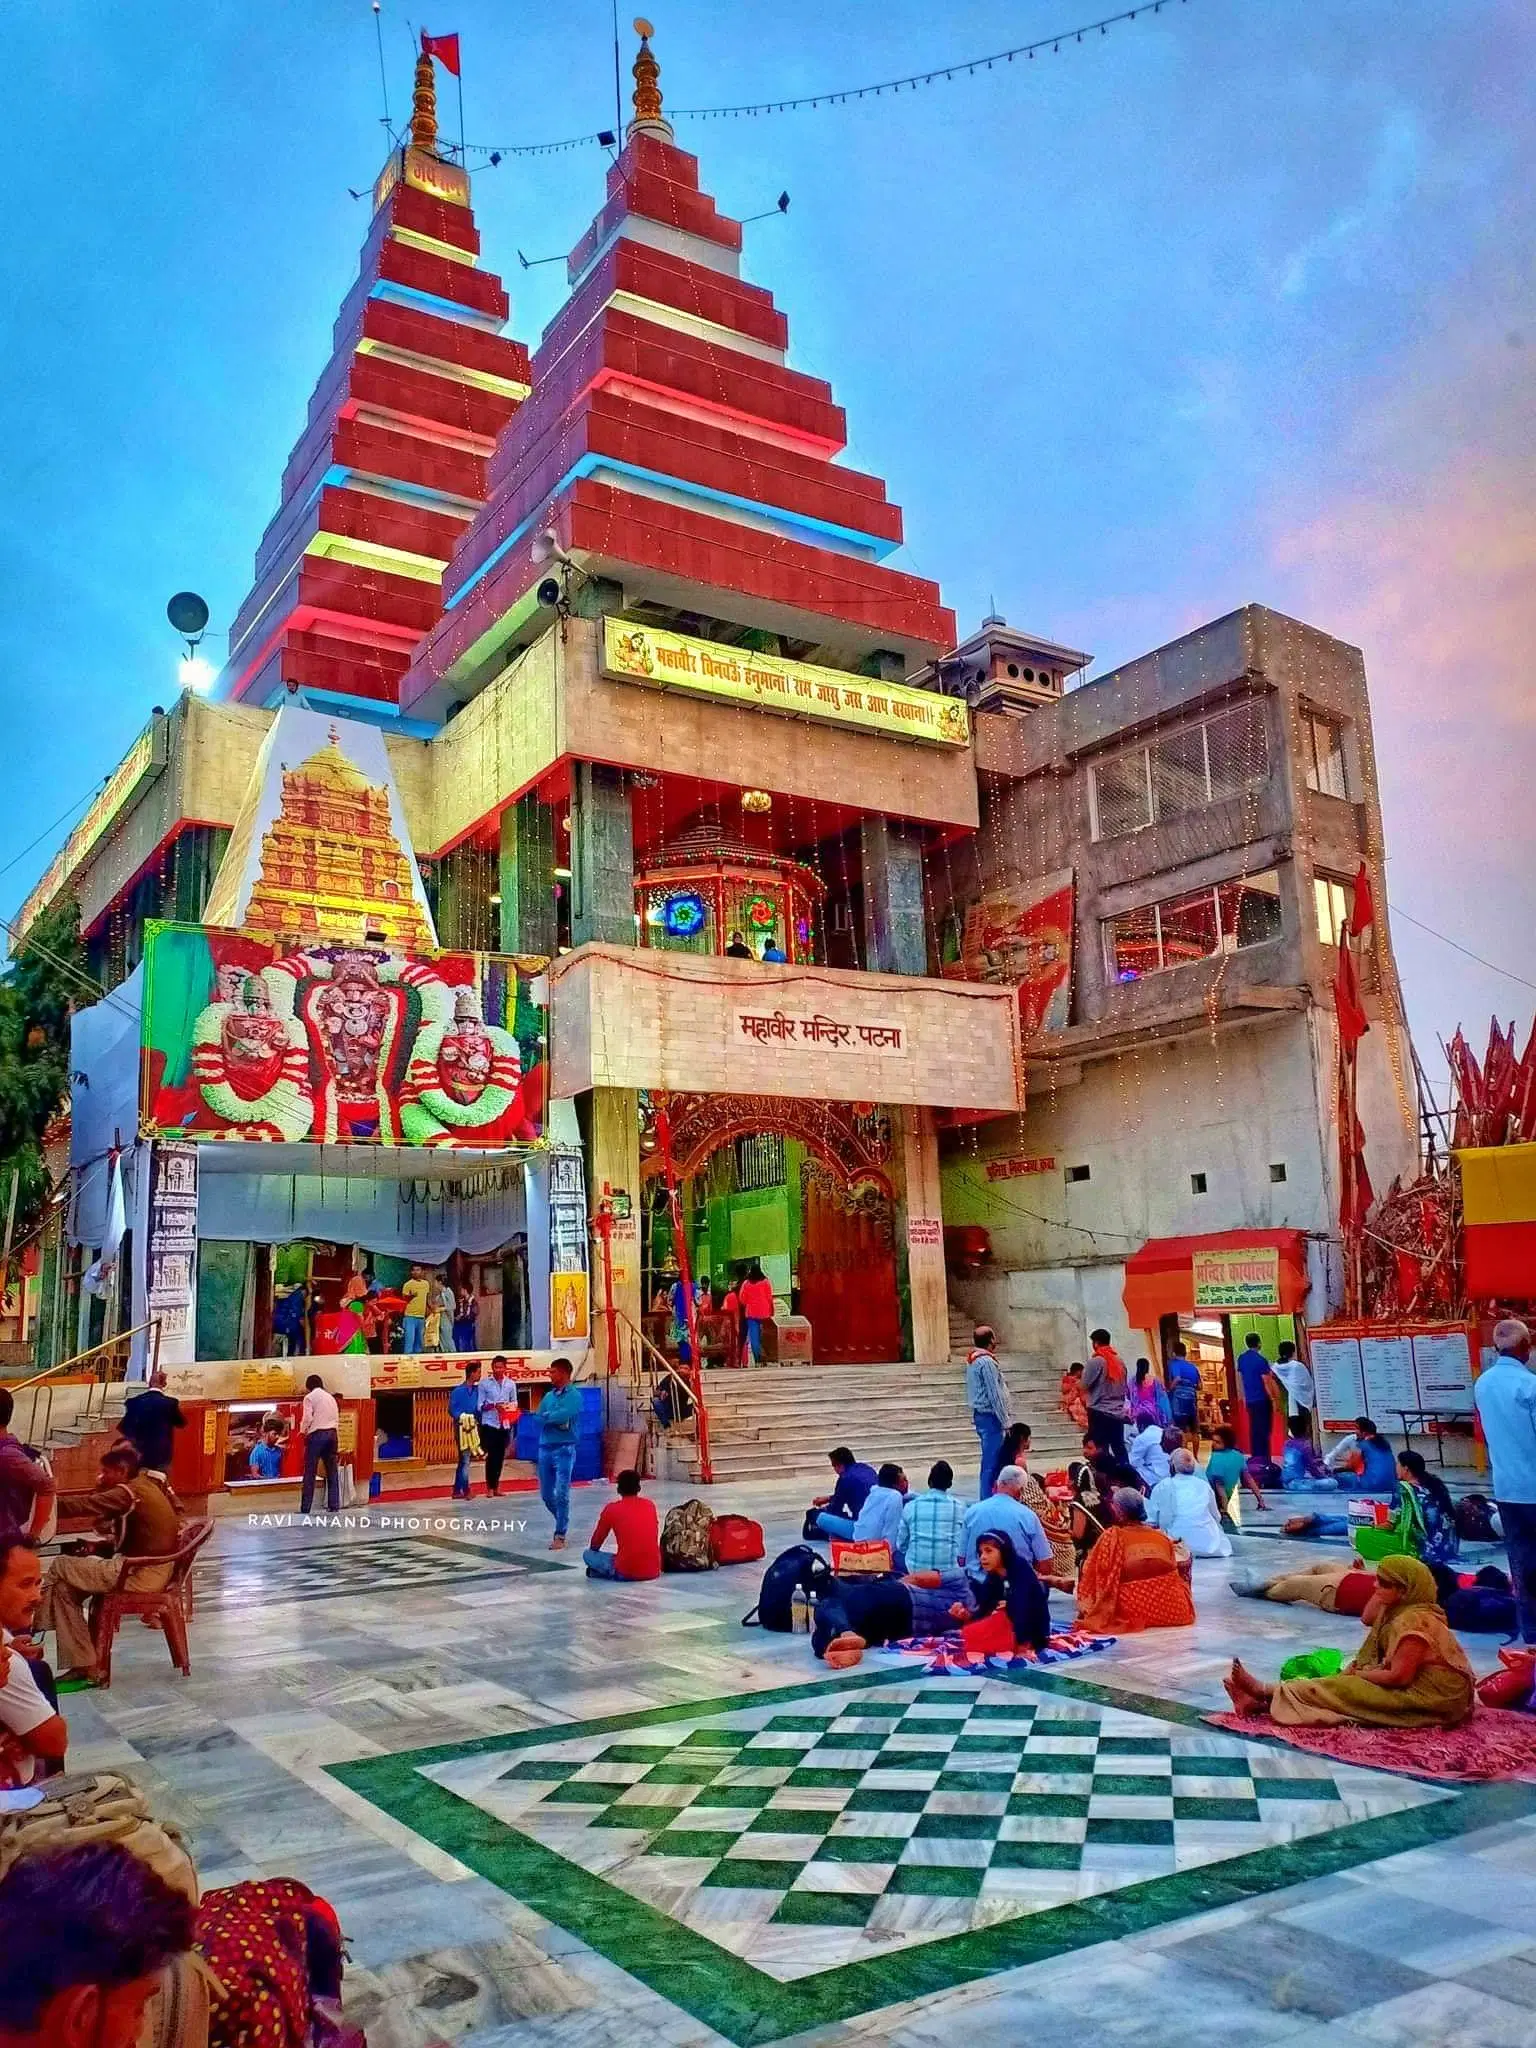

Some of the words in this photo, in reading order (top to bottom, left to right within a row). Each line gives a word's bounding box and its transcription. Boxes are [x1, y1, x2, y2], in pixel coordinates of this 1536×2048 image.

[793, 678, 812, 698] राम
[866, 694, 889, 715] आप
[739, 1010, 798, 1045] महावीर
[856, 1025, 902, 1049] पटना
